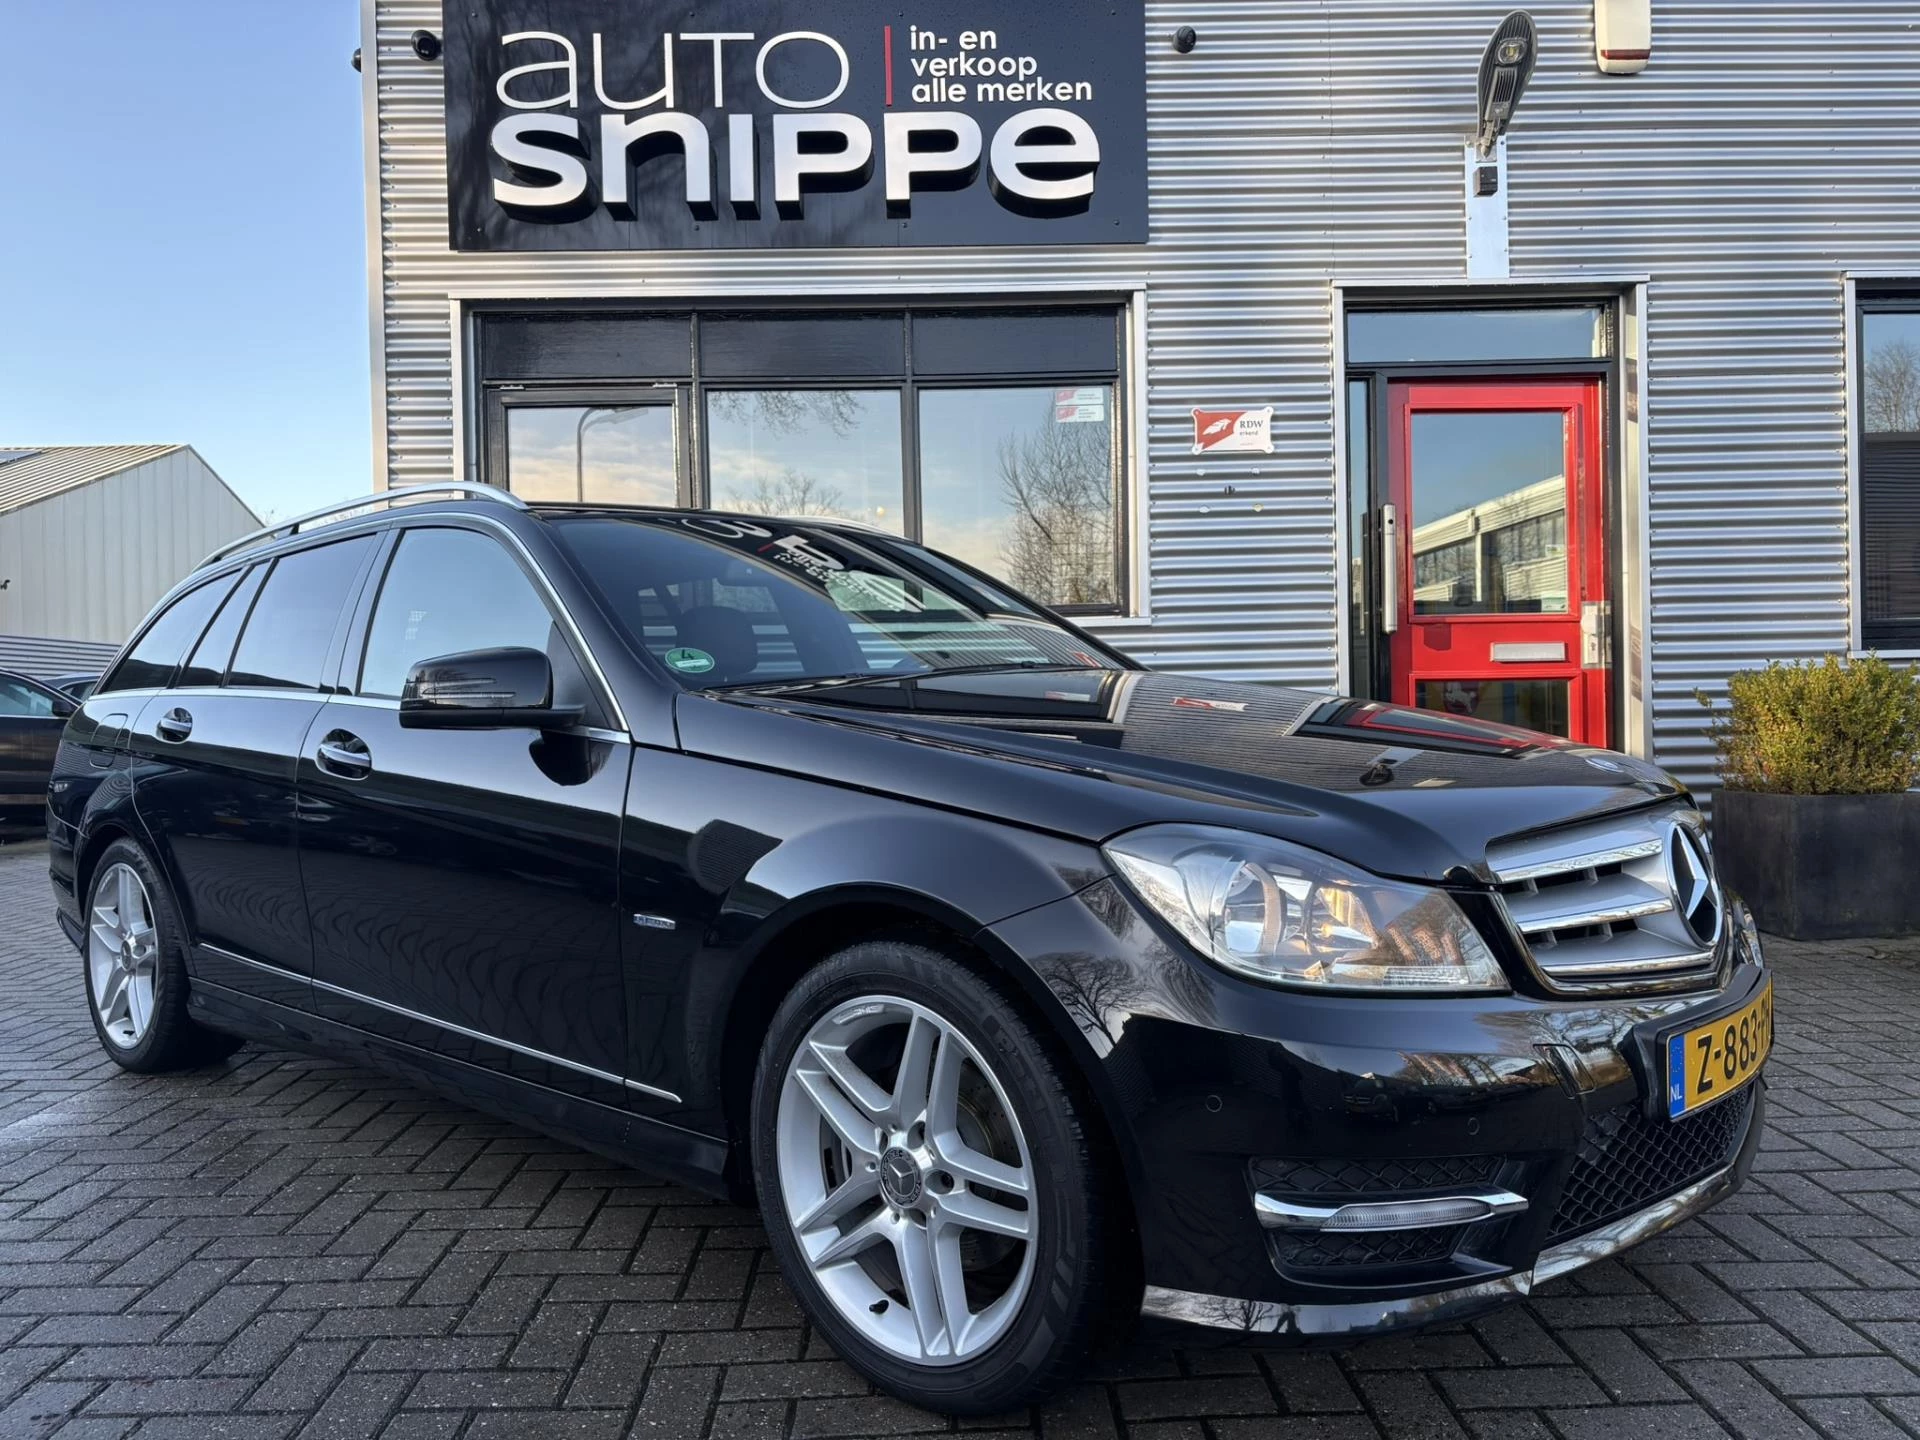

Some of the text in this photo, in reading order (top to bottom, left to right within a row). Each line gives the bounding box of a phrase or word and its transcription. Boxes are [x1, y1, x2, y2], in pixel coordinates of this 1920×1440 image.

[910, 25, 997, 50] in- en
[911, 51, 1038, 81] verkoop
[912, 76, 1092, 102] alle merken
[1240, 419, 1263, 429] RDW
[1670, 1084, 1682, 1102] NL
